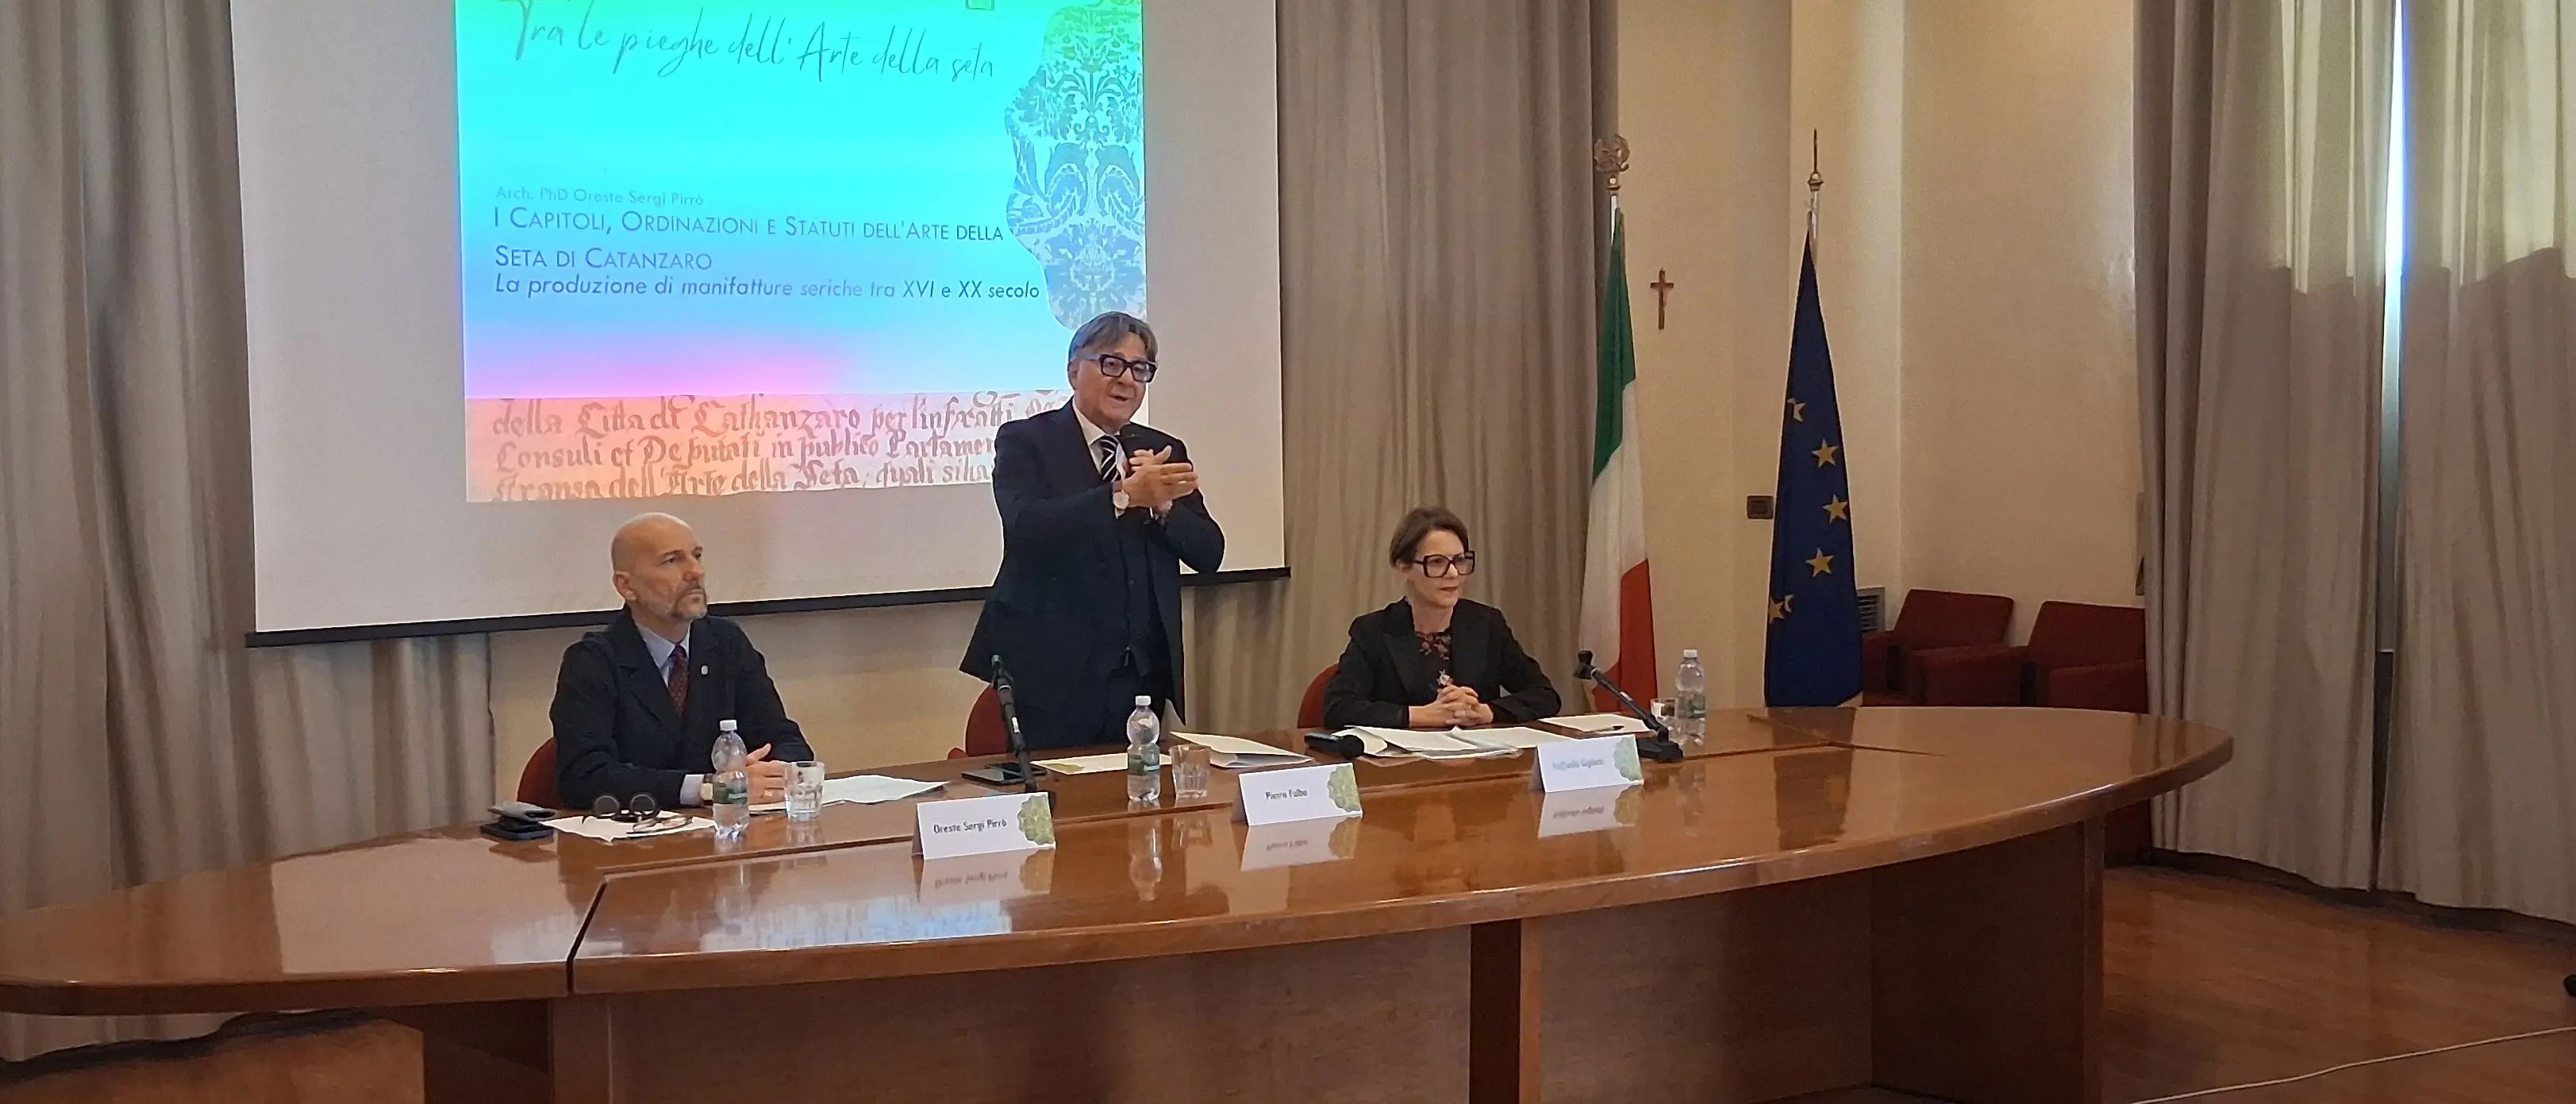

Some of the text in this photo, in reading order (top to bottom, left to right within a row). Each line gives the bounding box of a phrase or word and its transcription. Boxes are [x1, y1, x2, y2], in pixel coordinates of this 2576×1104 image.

[578, 0, 610, 49] le
[613, 7, 718, 77] pieghe
[872, 25, 938, 74] della
[952, 42, 993, 82] seta
[495, 187, 704, 206] Arch. PhD Oreste Sergi Pirrò
[494, 206, 499, 227] I
[956, 225, 1004, 241] DELLA
[556, 250, 575, 267] DI
[495, 273, 1040, 298] La produzione di manifatture seriche tra XVI e XX secolo
[493, 398, 562, 436] della
[771, 432, 794, 458] in
[732, 458, 787, 490] della
[933, 823, 961, 834] Oreste
